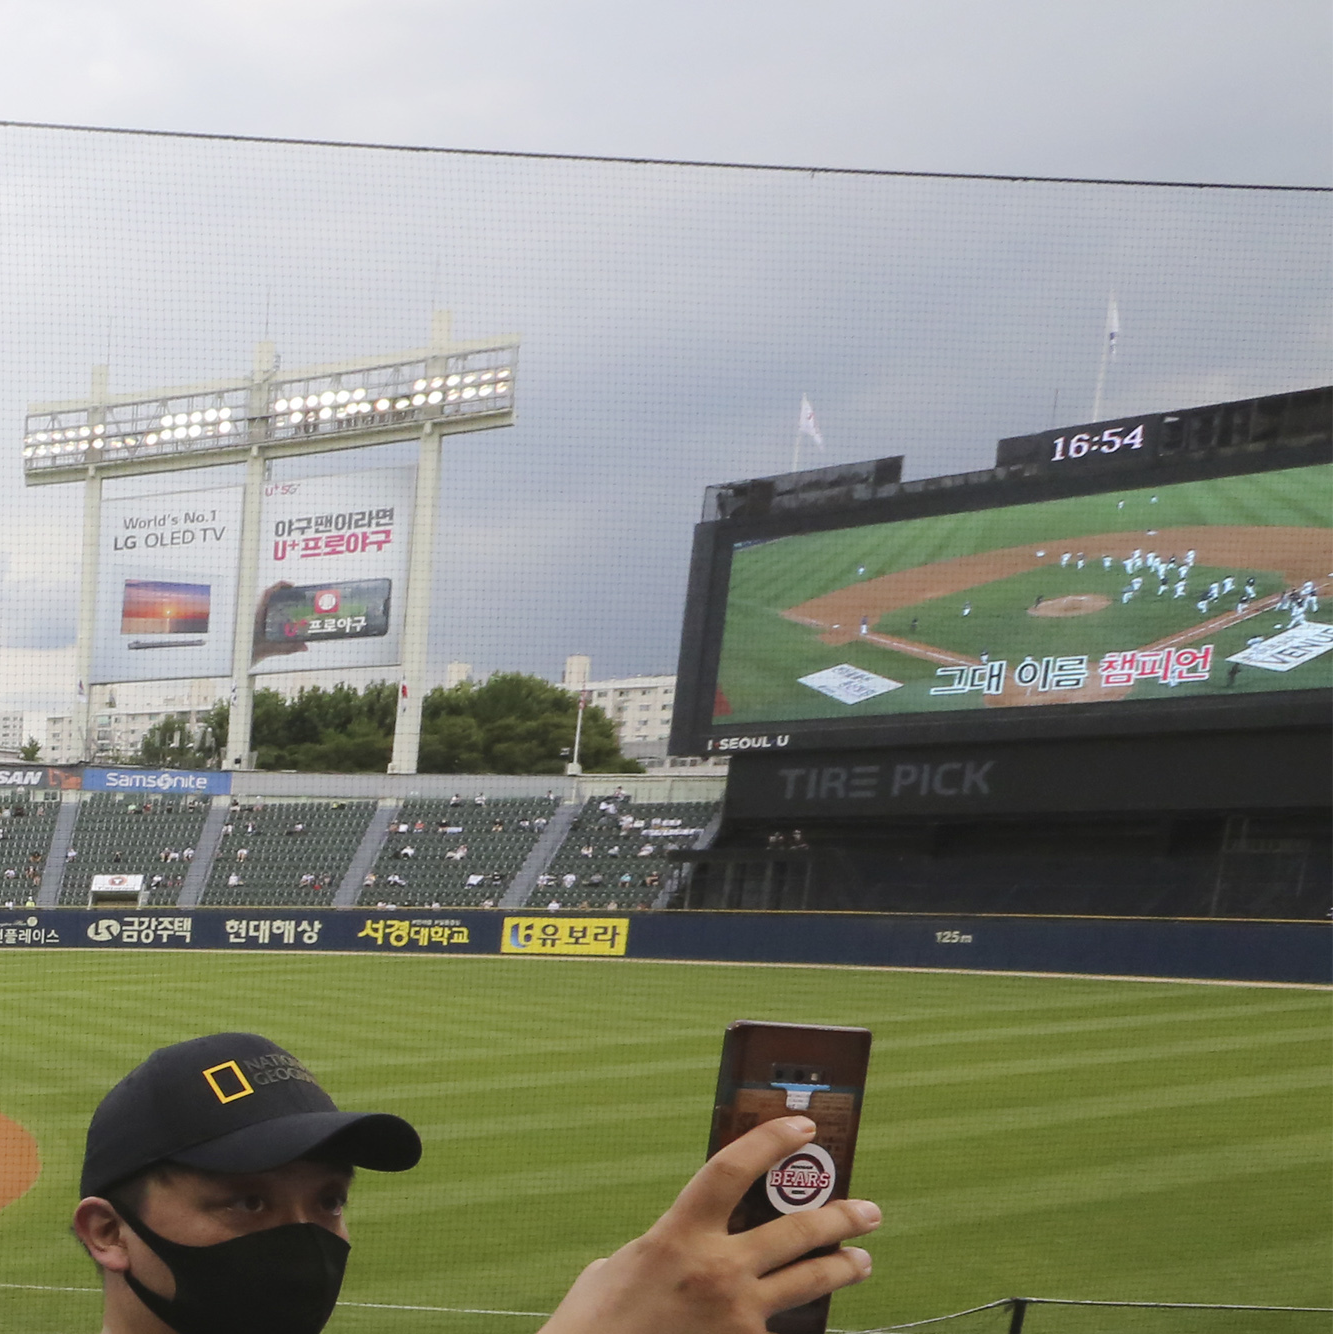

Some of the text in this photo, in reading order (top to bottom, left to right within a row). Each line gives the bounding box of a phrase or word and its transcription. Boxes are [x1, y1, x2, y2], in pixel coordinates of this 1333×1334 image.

[1050, 424, 1144, 462] 16:54
[123, 509, 217, 530] World's No.1
[274, 507, 395, 537] 야구팬이라면
[113, 526, 227, 551] LG OLED TV
[929, 660, 1007, 695] 그대
[1014, 654, 1089, 692] 이름
[1098, 645, 1214, 689] 챔피언
[719, 735, 772, 751] SEOUL
[778, 759, 997, 801] TIRE PICK
[121, 916, 192, 944] 금강주택
[224, 918, 323, 945] 현대해상
[356, 918, 471, 948] 서경대학교
[535, 923, 622, 949] 유보라
[935, 930, 973, 945] 125m
[769, 1168, 831, 1189] BEARS
